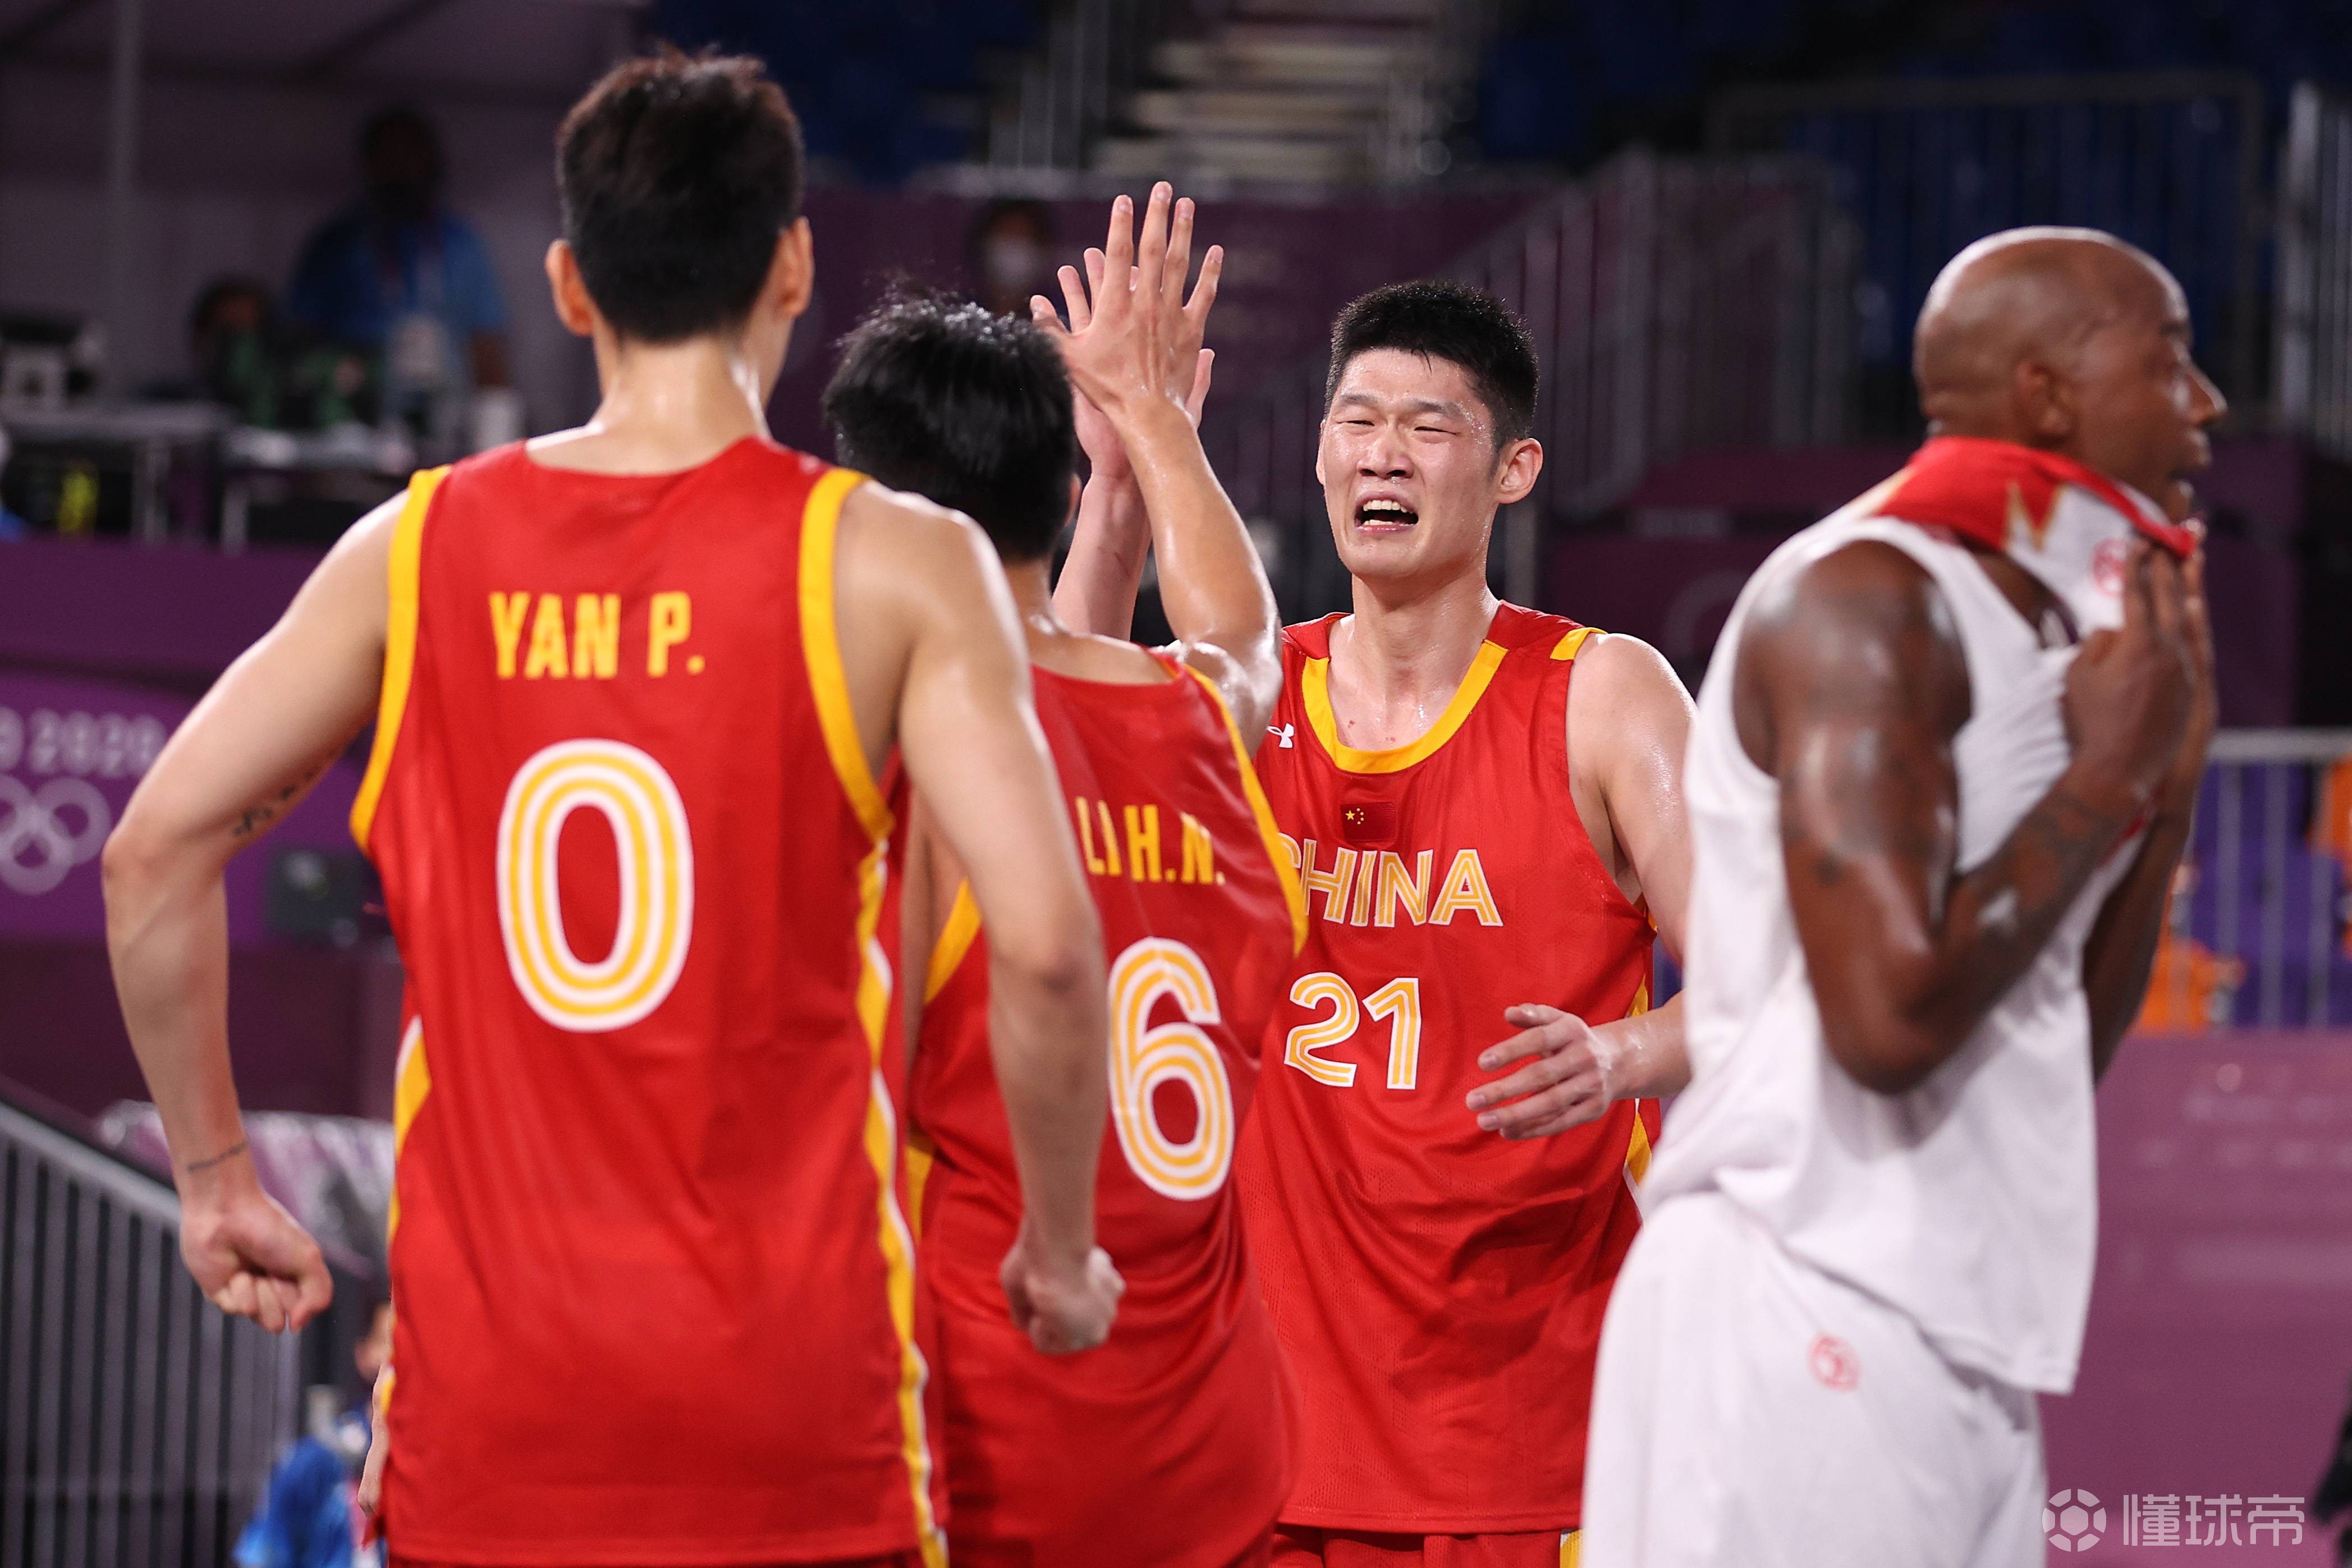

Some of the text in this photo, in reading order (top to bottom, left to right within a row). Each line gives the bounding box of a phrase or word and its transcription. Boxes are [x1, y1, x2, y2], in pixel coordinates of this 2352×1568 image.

[489, 591, 705, 679] YAN P.
[496, 738, 695, 1033] 0
[1277, 832, 1504, 928] HINA
[1108, 935, 1235, 1200] 6
[1283, 971, 1422, 1090] 21
